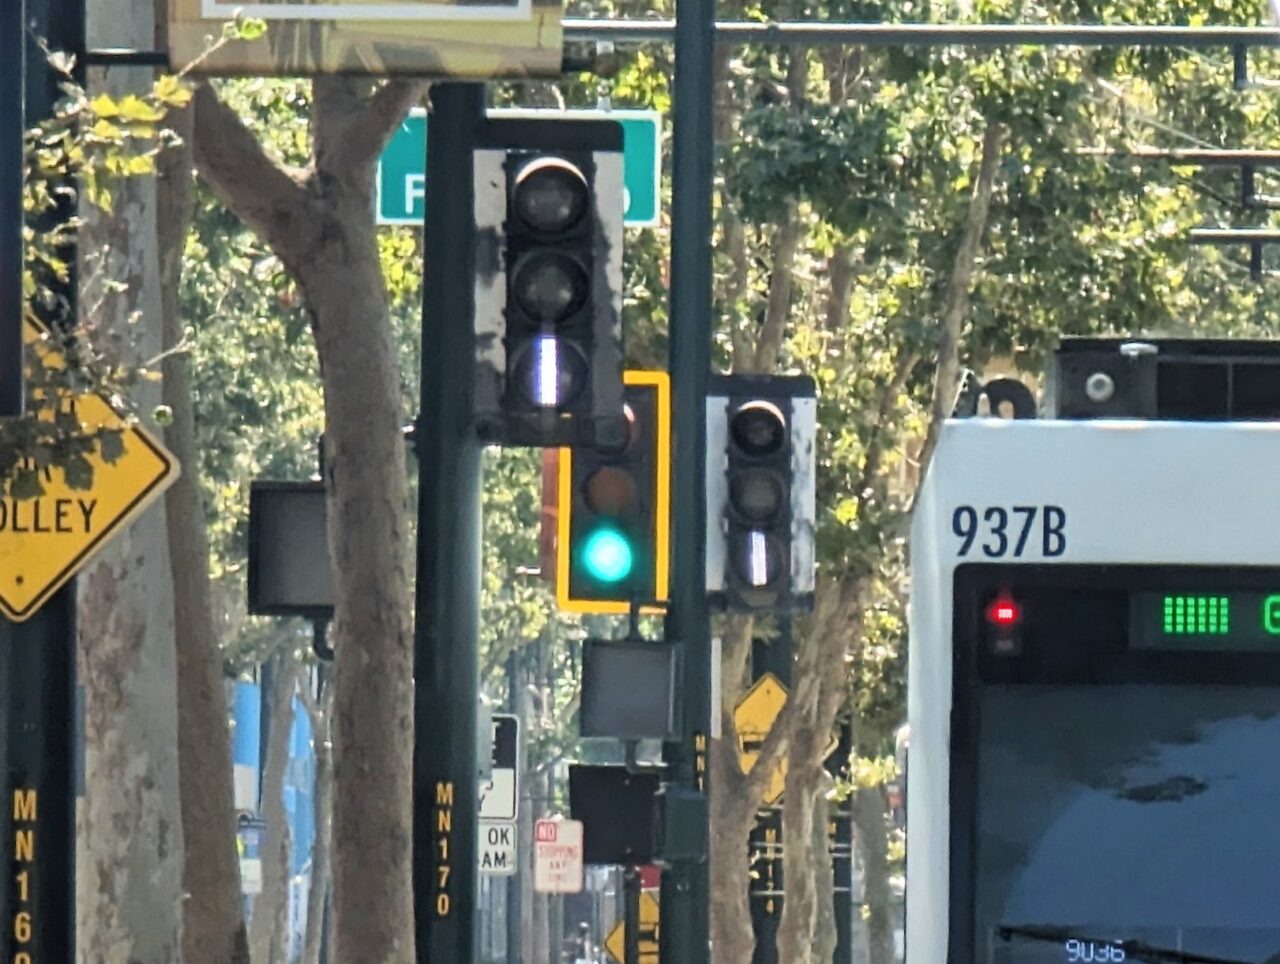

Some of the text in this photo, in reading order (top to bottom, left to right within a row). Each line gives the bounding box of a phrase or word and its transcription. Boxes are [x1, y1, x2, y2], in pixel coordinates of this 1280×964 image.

[952, 505, 1066, 557] 937B
[436, 782, 453, 916] MN170
[488, 827, 510, 845] OK
